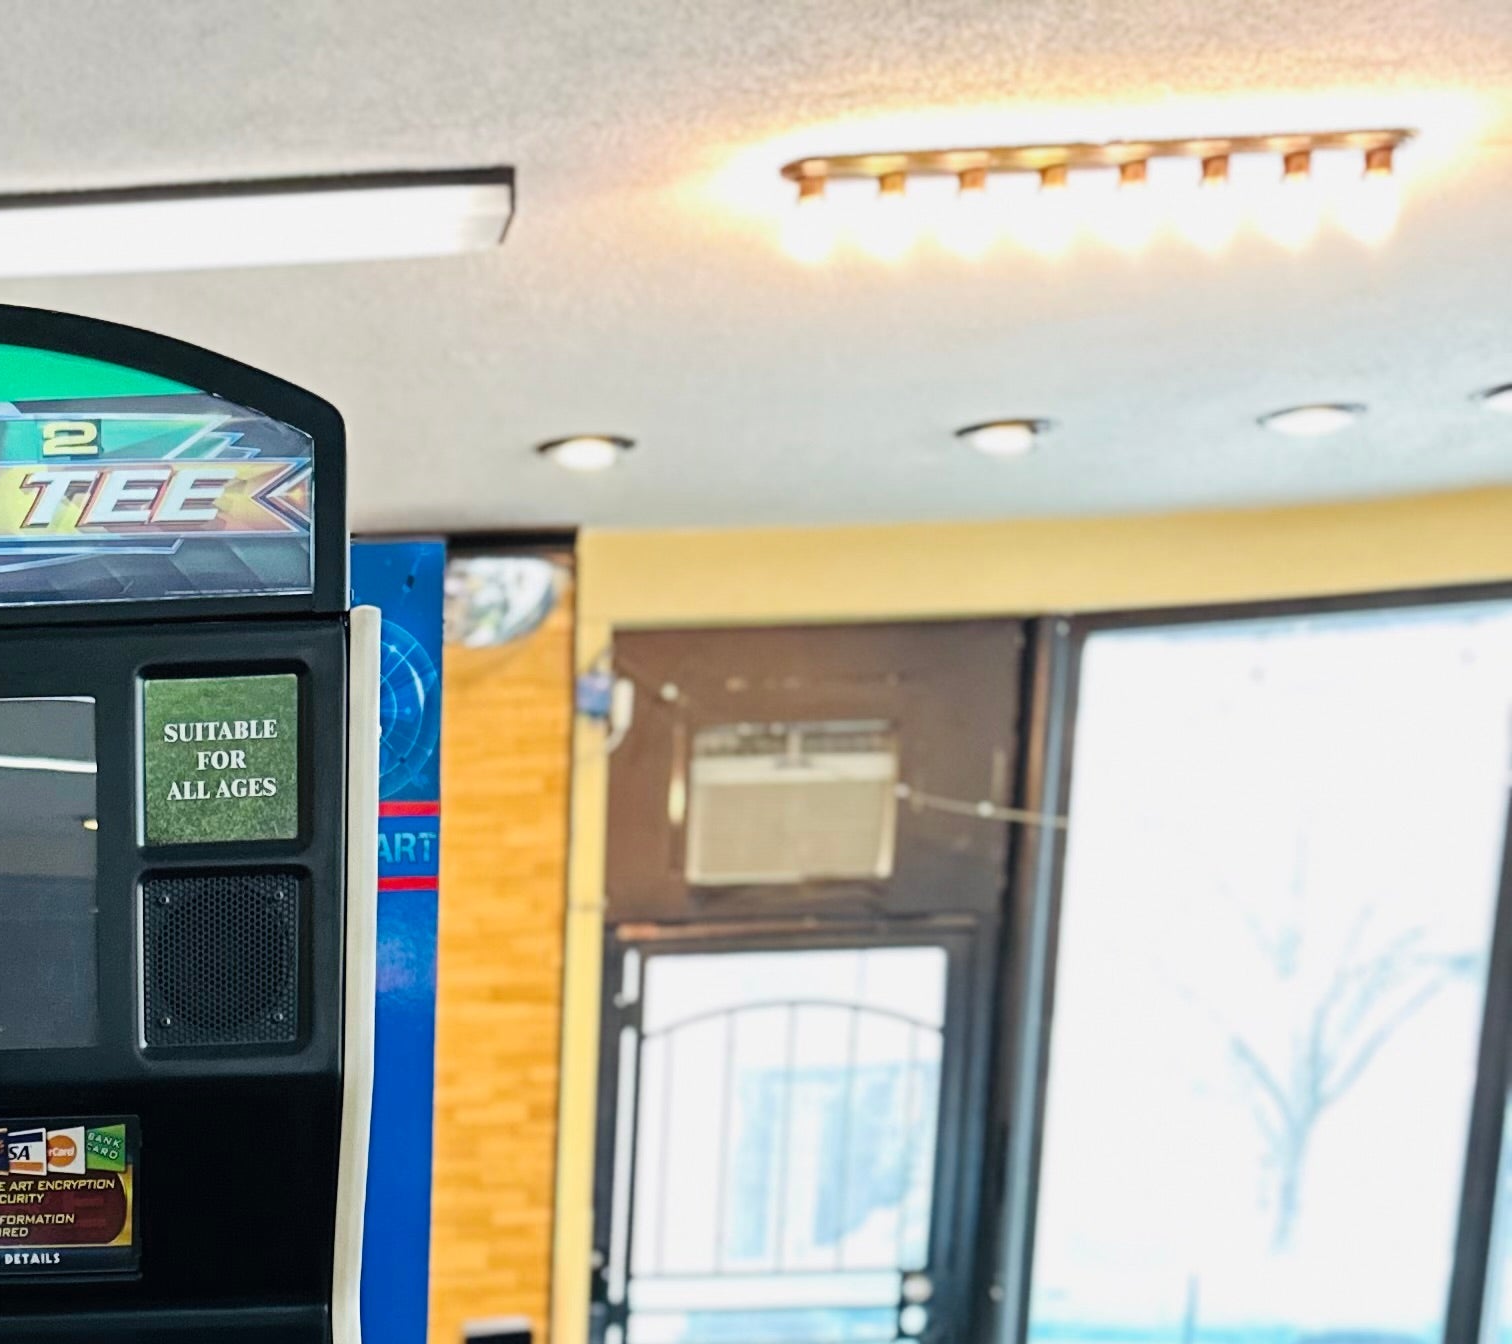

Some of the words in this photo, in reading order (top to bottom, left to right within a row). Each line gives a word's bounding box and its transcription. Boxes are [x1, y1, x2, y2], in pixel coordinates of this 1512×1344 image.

[21, 466, 236, 530] TEE
[163, 719, 278, 743] SUITABLE
[196, 750, 246, 770] FOR
[166, 781, 210, 801] ALL
[215, 777, 277, 798] AGES
[88, 1131, 122, 1149] BANK
[9, 1180, 35, 1191] ART
[38, 1178, 116, 1191] ENCRYPTION
[4, 1252, 61, 1265] DETAILS
